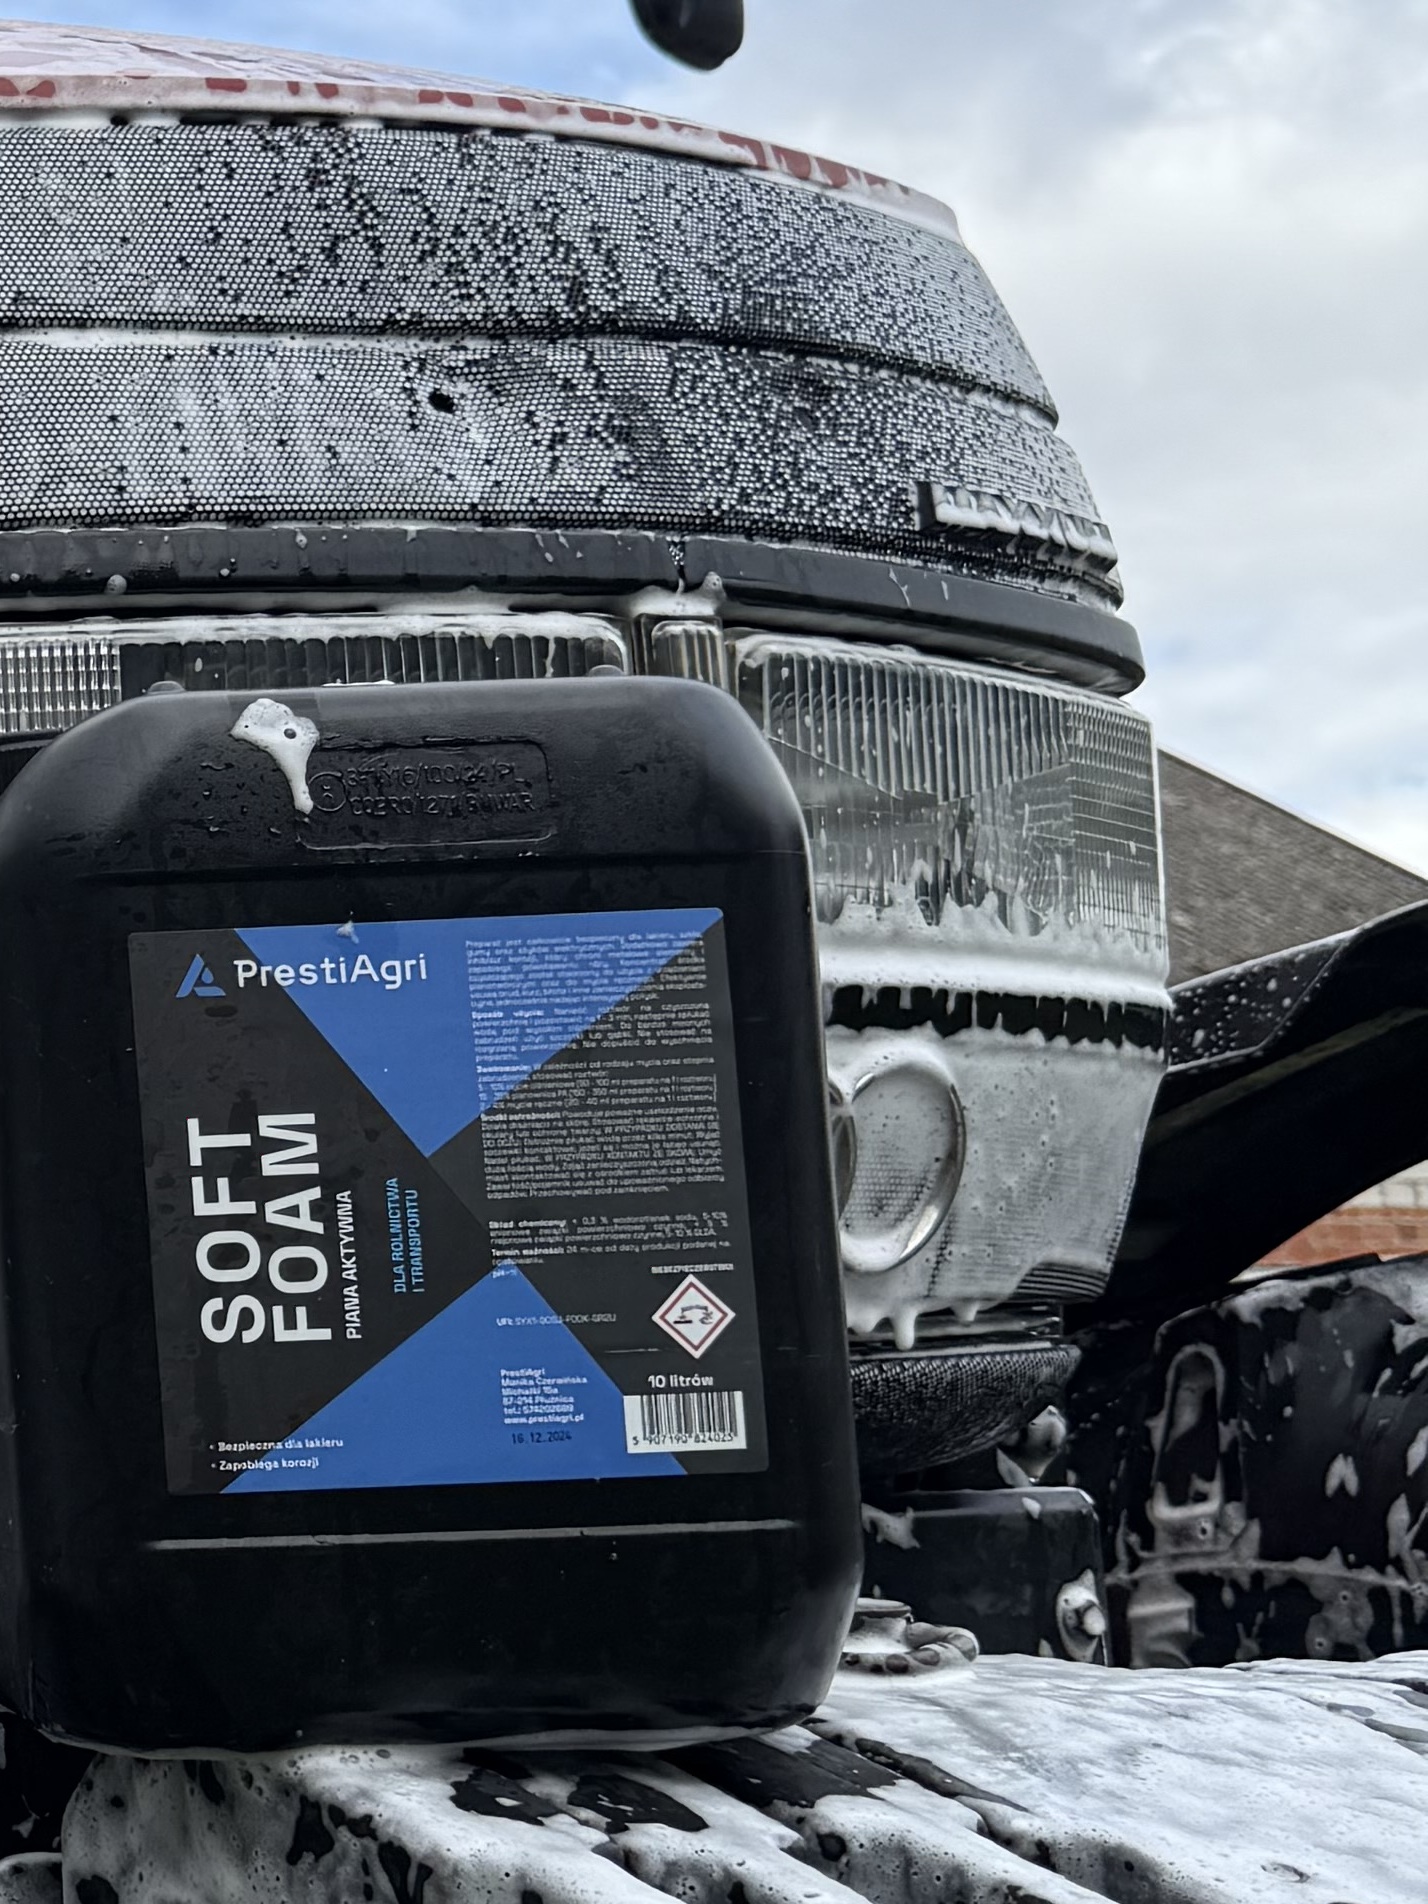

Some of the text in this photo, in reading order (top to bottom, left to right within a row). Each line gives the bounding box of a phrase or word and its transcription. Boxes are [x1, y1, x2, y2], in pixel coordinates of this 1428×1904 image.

[234, 953, 427, 990] PrestiAgri
[187, 1118, 265, 1343] SOFT
[258, 1113, 332, 1342] FOAM
[336, 1190, 362, 1339] PIANA AKTYWNA
[385, 1177, 406, 1292] DLA ROLNICTWA
[405, 1190, 424, 1284] TRANSPORTU
[647, 1374, 714, 1388] 10 litrów
[218, 1438, 343, 1451] Bezpieczna dla lakieru
[219, 1457, 319, 1471] Zapobiega korozji
